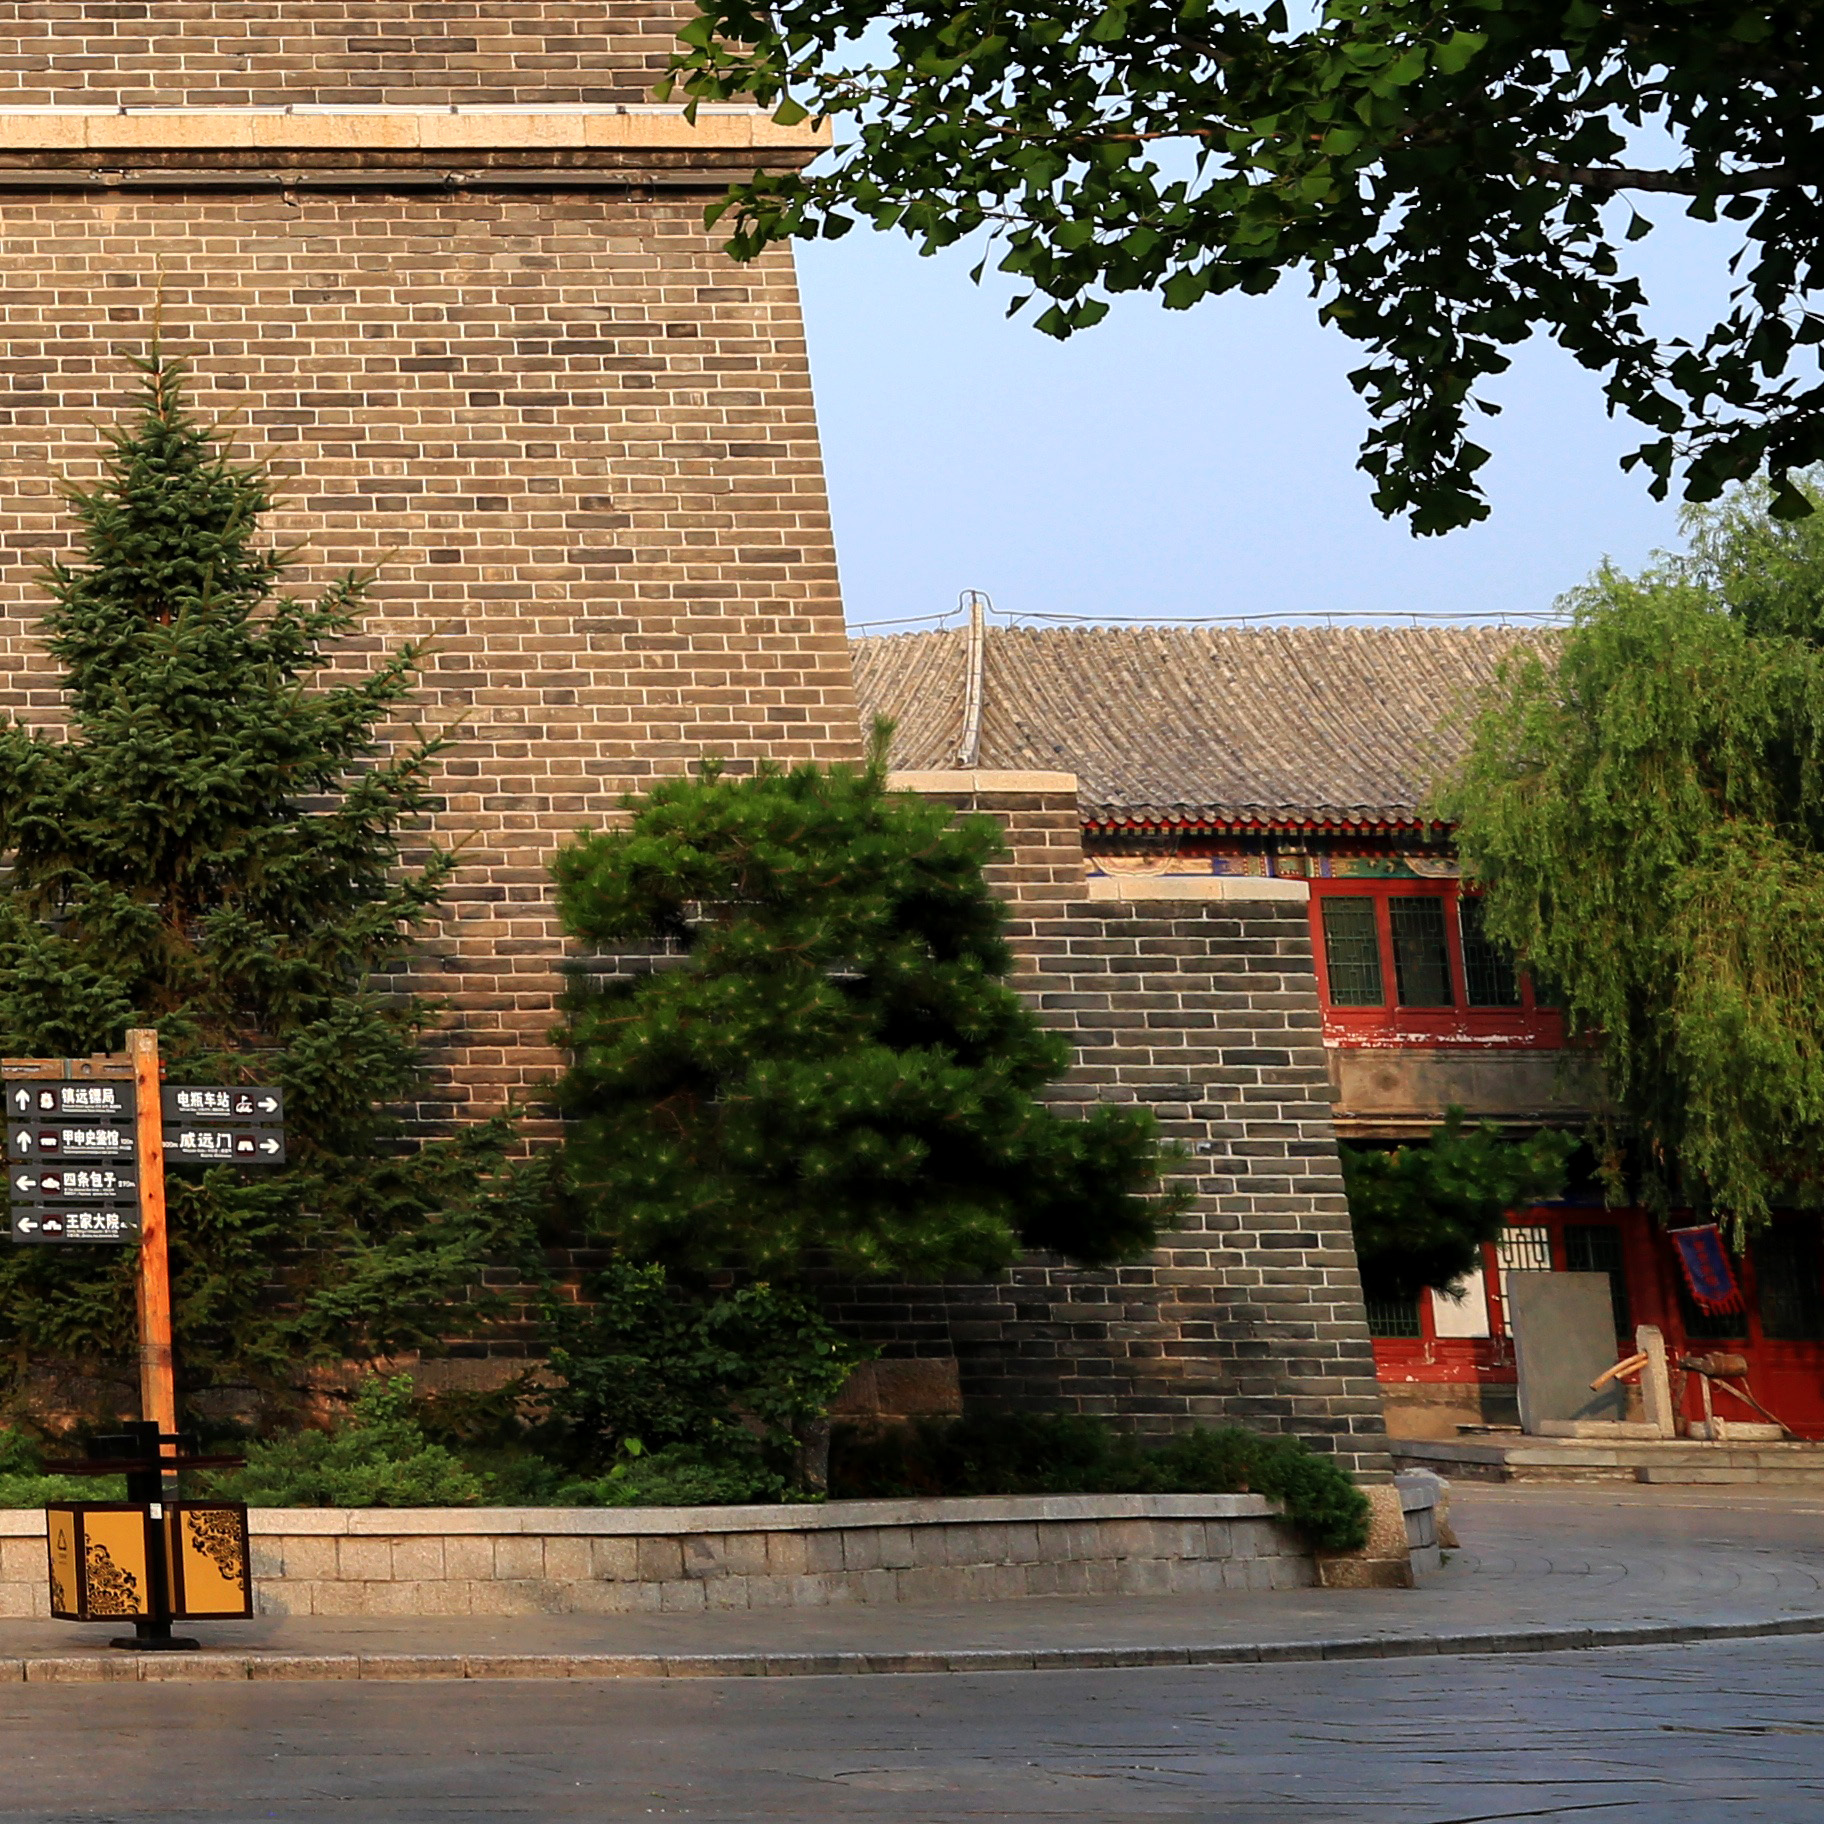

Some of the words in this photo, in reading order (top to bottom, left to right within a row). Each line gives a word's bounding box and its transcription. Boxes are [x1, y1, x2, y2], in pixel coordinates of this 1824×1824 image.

[61, 1087, 115, 1104] 镇远镖局
[177, 1090, 230, 1108] 电瓶车站
[62, 1129, 119, 1146] 甲申史鉴馆
[179, 1132, 232, 1149] 威远门
[63, 1171, 117, 1188] 四条包子
[65, 1212, 120, 1230] 王家大院
